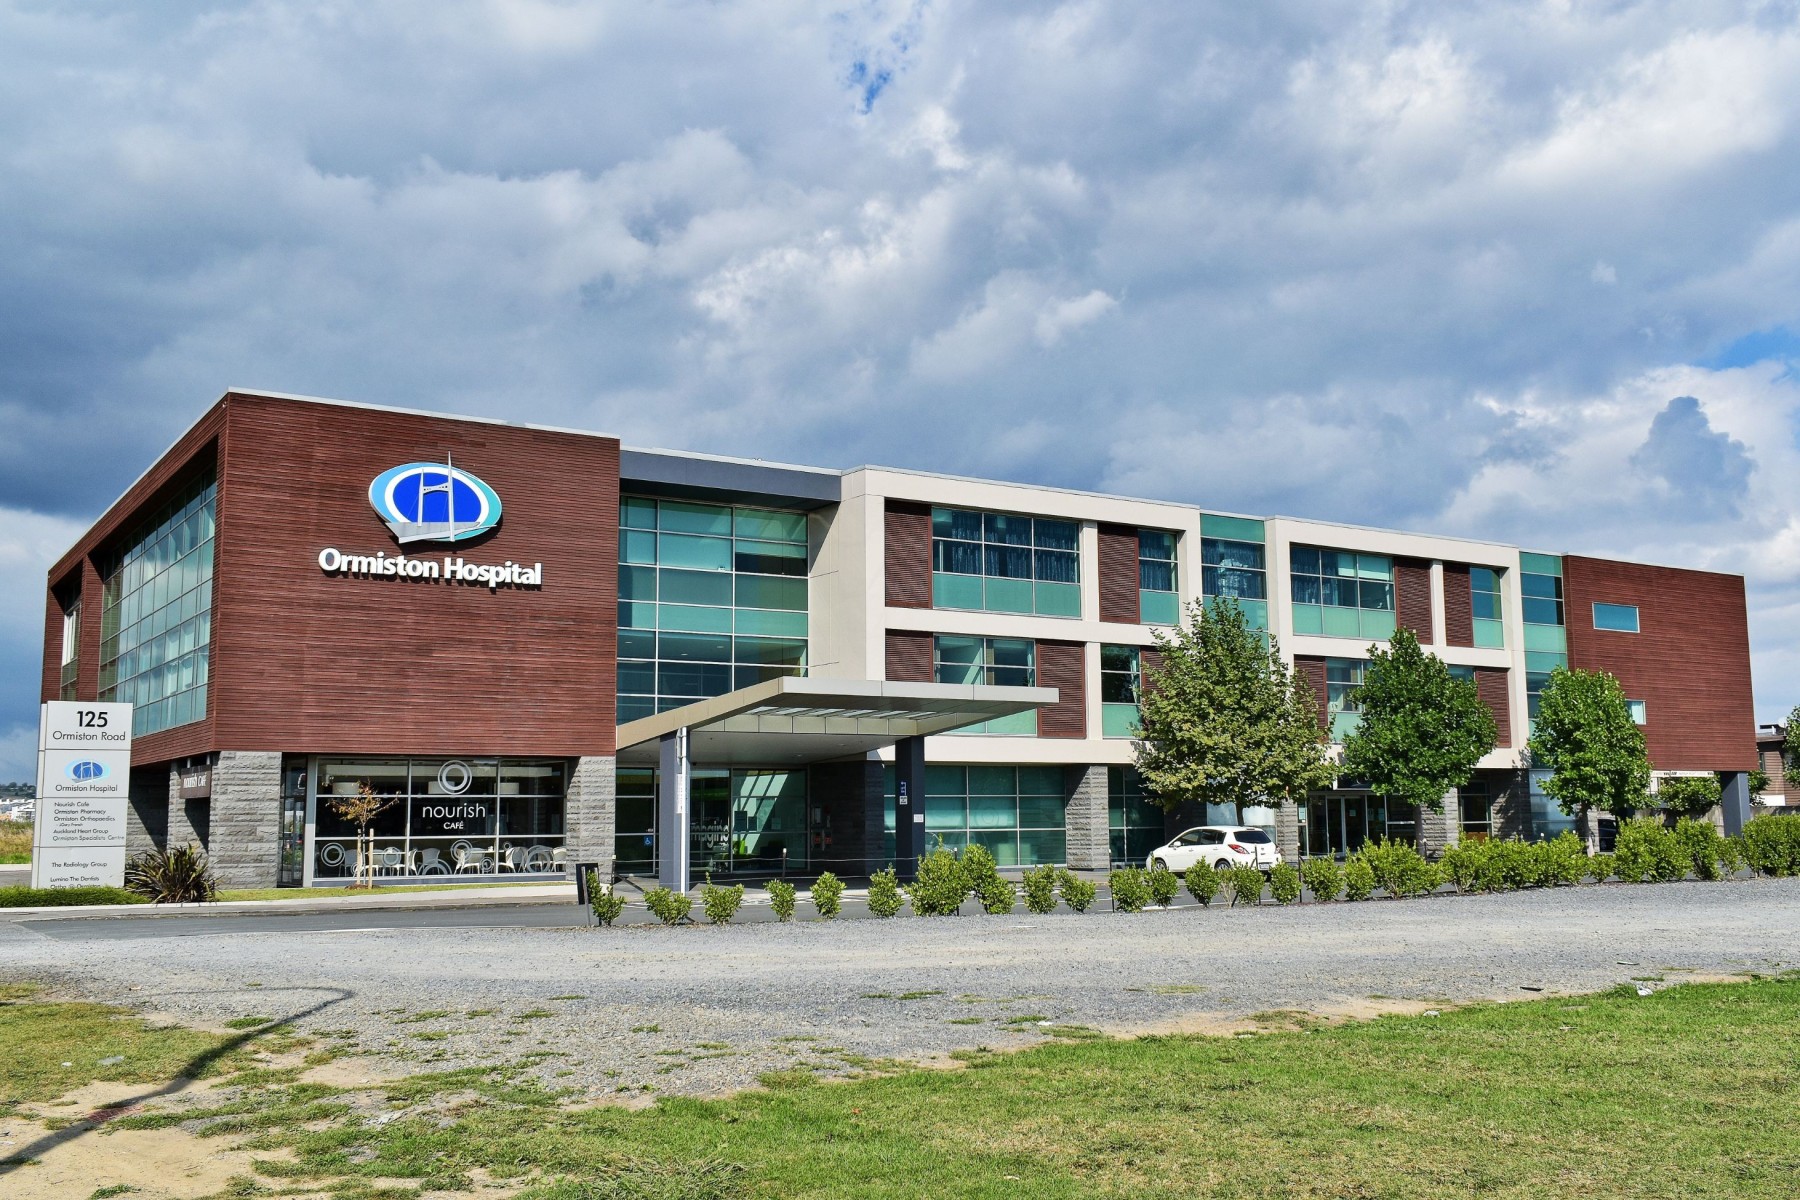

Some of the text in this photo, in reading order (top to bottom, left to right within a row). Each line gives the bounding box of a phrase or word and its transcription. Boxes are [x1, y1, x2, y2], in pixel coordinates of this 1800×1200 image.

[318, 548, 542, 588] Ormiston Hospital
[76, 710, 108, 728] 125
[52, 730, 126, 741] Ormiston Road
[55, 784, 118, 793] Ormiston Hospital
[422, 803, 486, 818] nourish
[443, 821, 464, 830] CAFÉ
